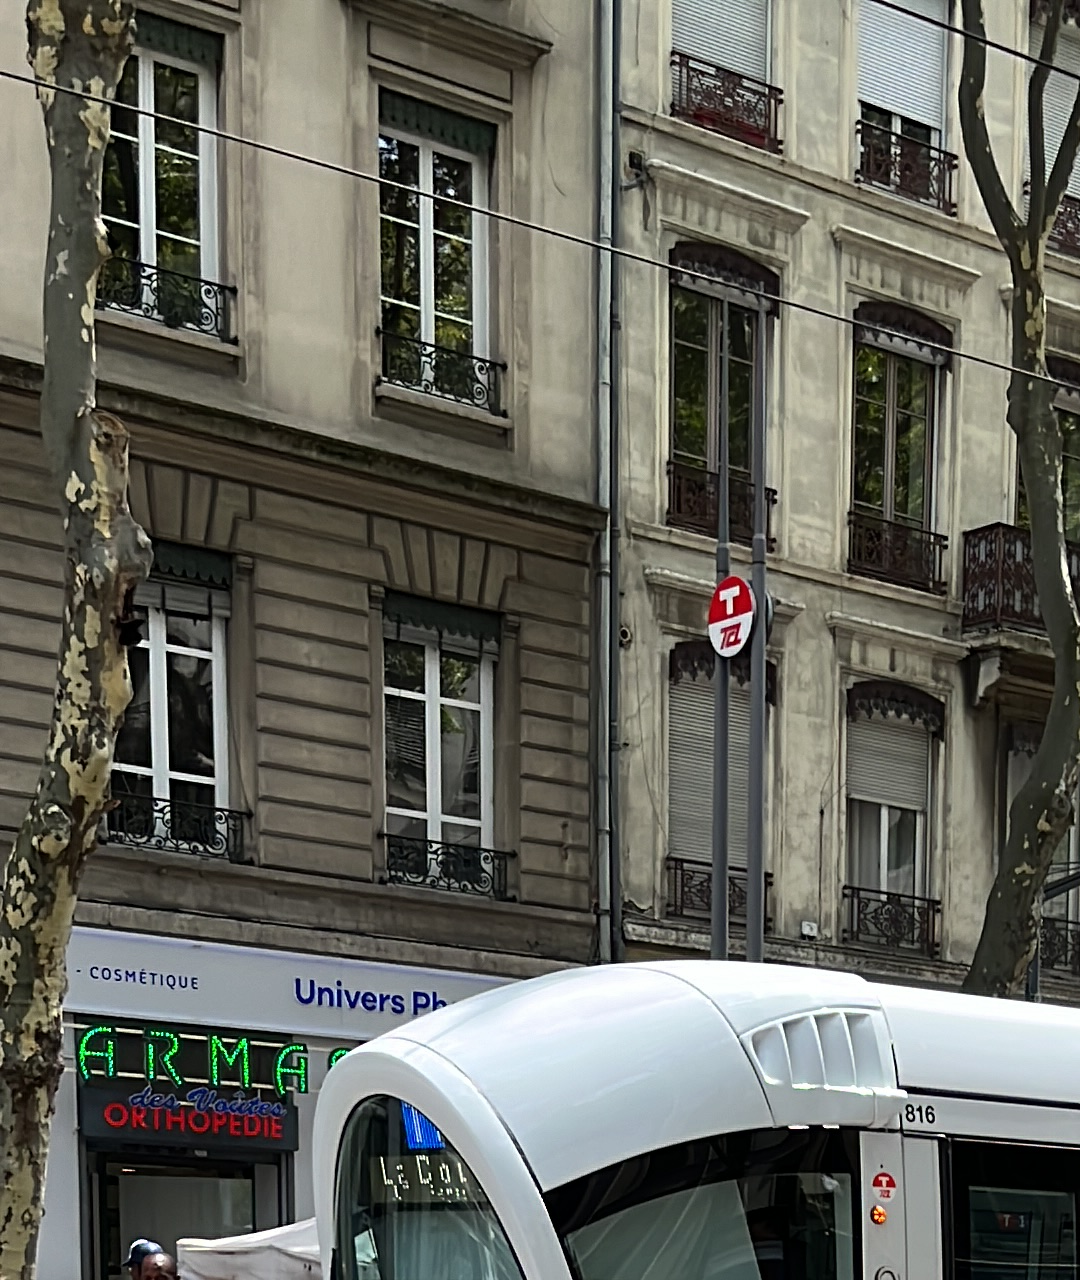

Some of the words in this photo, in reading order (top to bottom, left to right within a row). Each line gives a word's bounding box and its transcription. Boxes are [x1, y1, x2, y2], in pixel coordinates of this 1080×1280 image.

[719, 585, 741, 615] T
[720, 622, 742, 650] TCL
[89, 966, 199, 990] COSMÉTIQUE
[294, 978, 405, 1015] Univers
[129, 1086, 181, 1110] des
[104, 1103, 284, 1139] ORTHOPEDIE
[904, 1104, 936, 1124] 816
[878, 1176, 890, 1188] T
